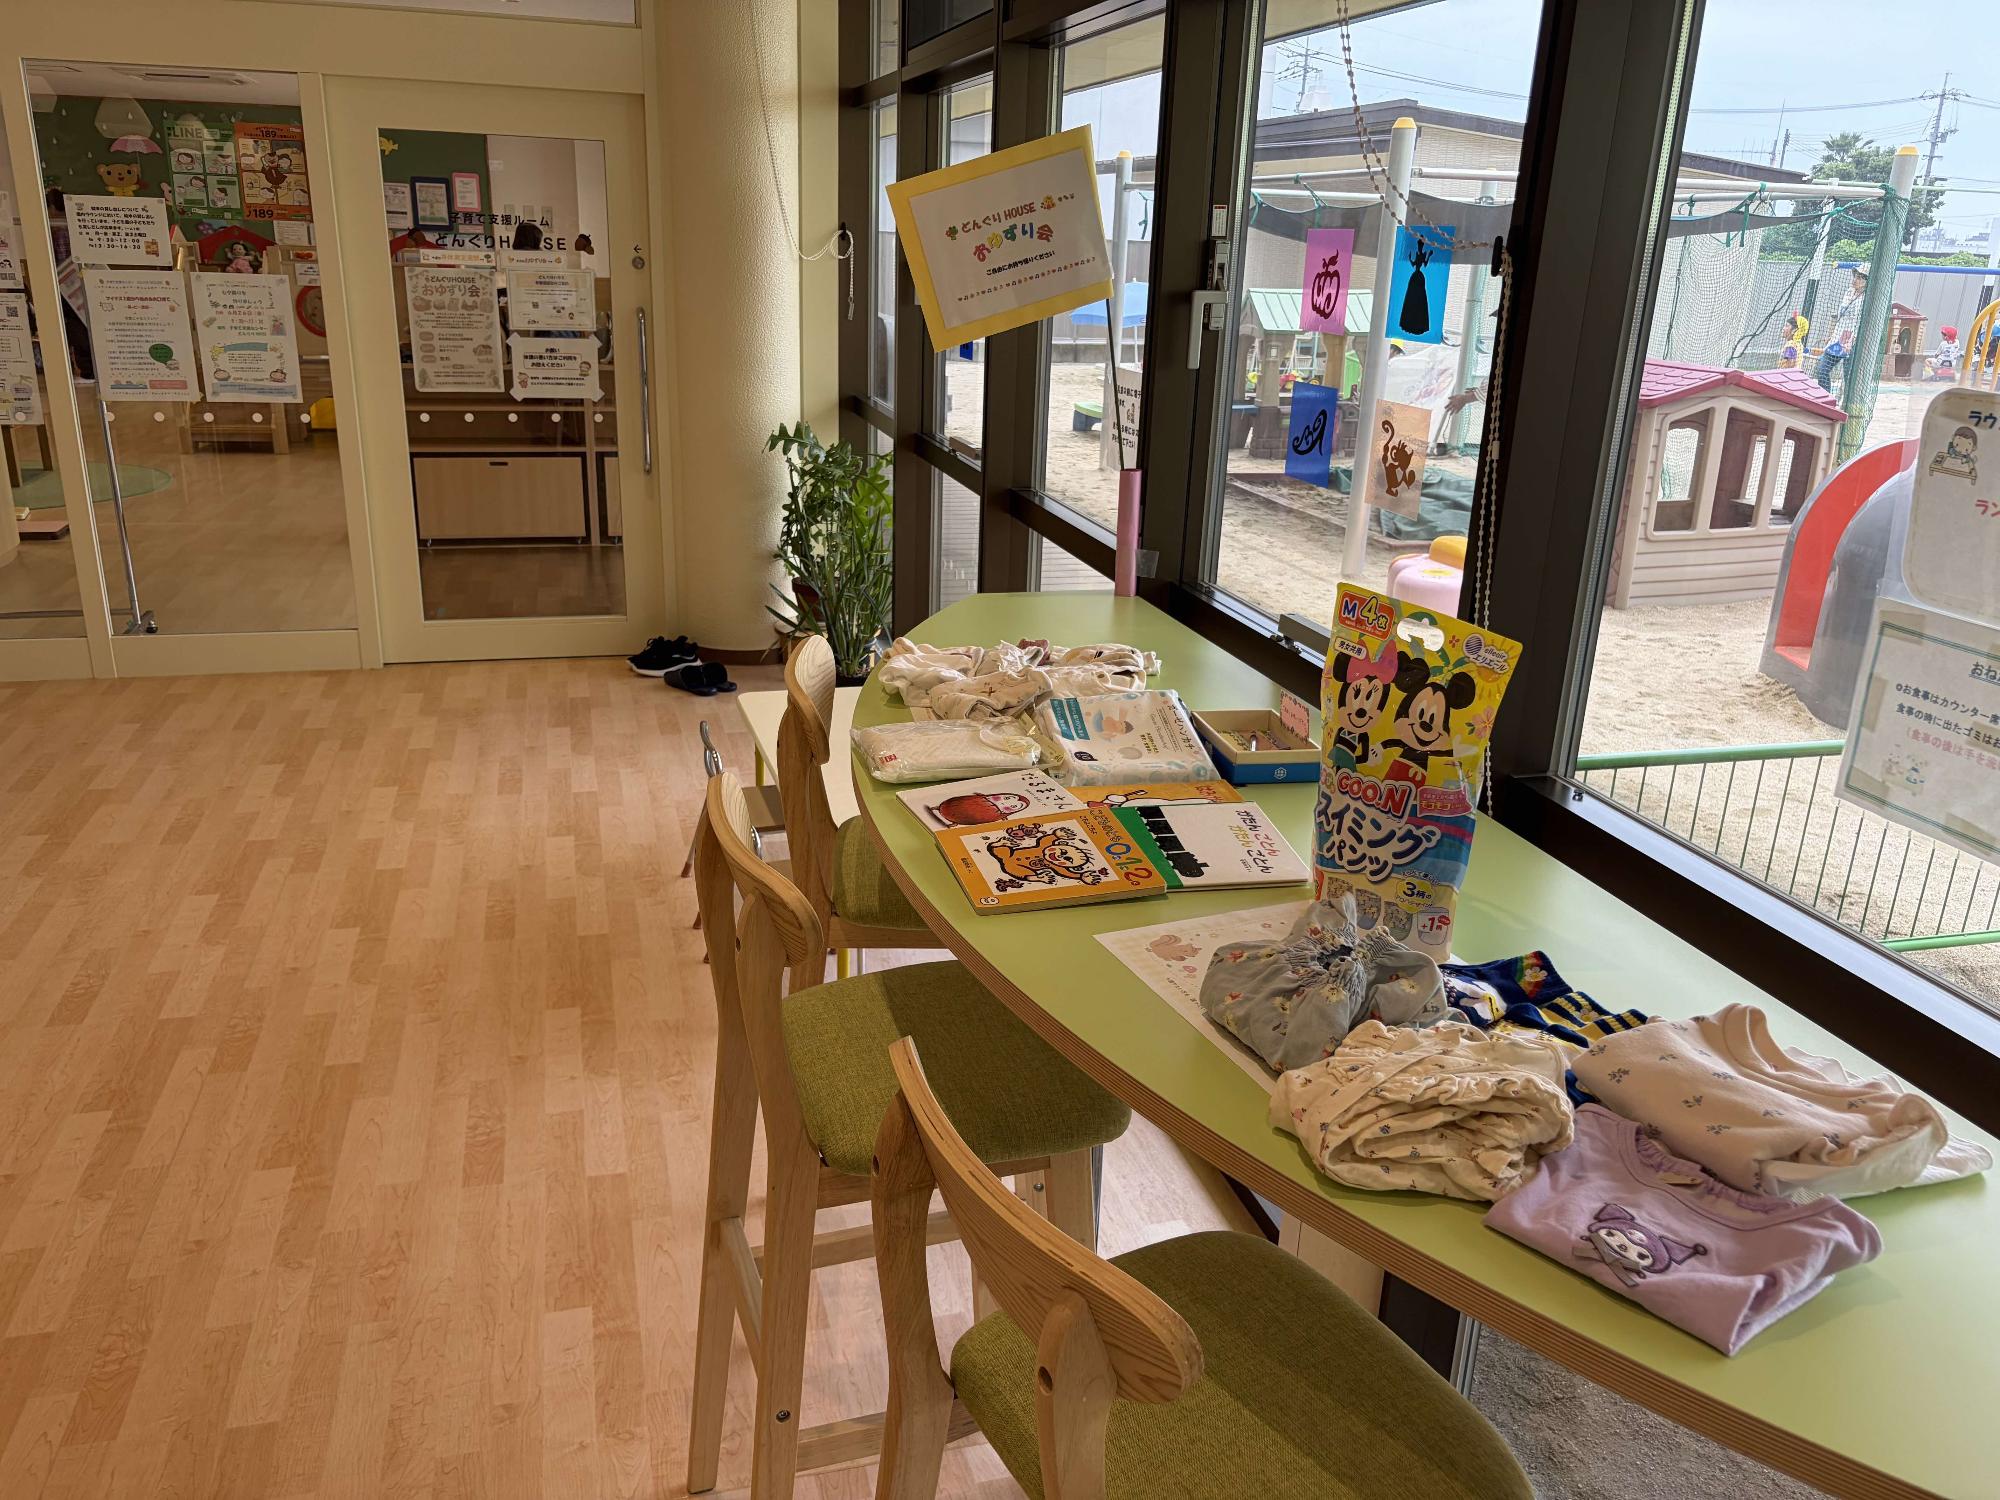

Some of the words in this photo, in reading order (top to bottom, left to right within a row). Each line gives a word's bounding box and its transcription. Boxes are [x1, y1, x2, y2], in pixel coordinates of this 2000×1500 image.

[172, 127, 203, 139] LINE
[261, 129, 277, 138] 189
[252, 208, 274, 218] 189
[449, 212, 551, 227] 子育て支援ルーム
[1003, 202, 1037, 221] HOUSE
[435, 232, 567, 250] どんぐりHSE
[972, 222, 1054, 263] おゆずり会
[421, 284, 481, 298] おゆずり会
[1484, 647, 1507, 660] elleair
[1472, 654, 1508, 672] エリエール
[1315, 790, 1437, 860] スイミング
[1325, 839, 1390, 878] パンツ
